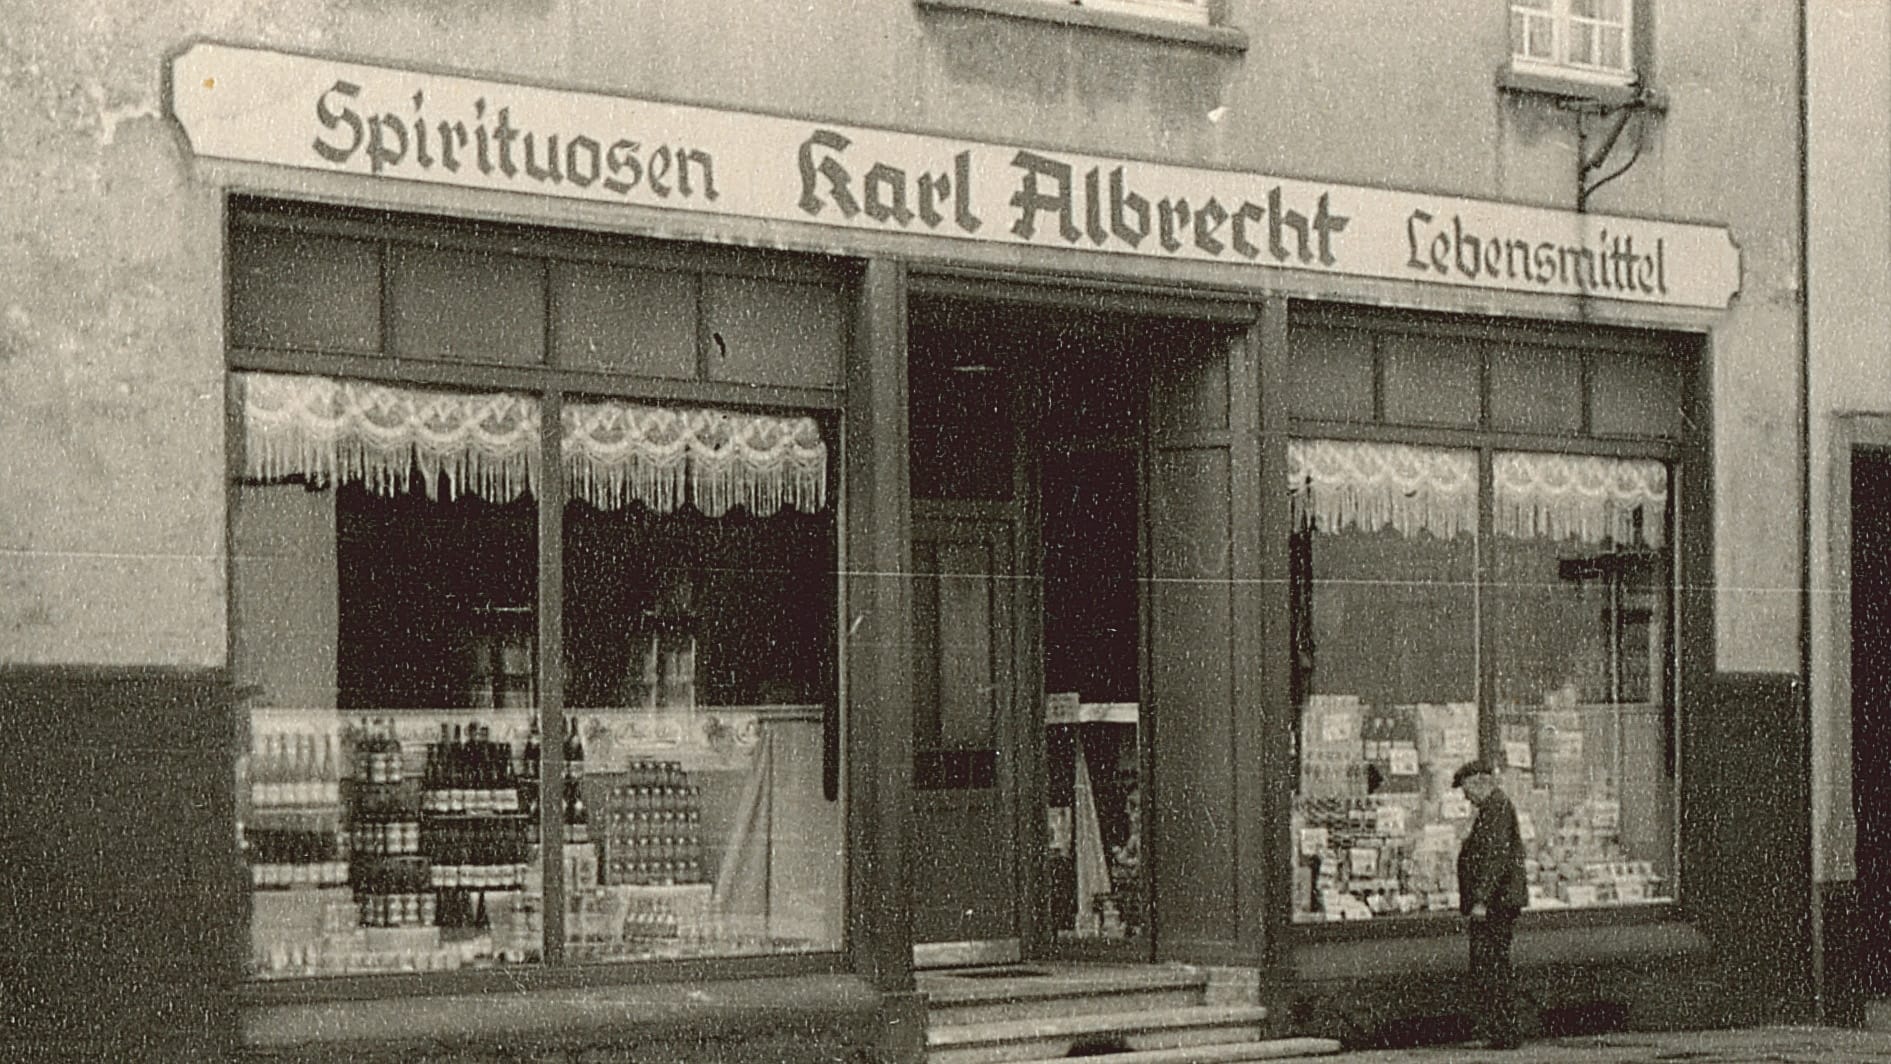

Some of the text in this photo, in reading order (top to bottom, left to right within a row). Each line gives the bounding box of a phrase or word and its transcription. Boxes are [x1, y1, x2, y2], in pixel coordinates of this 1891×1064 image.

[312, 80, 1667, 295] Spirituosen Karl Albrecht Lebensmittel
